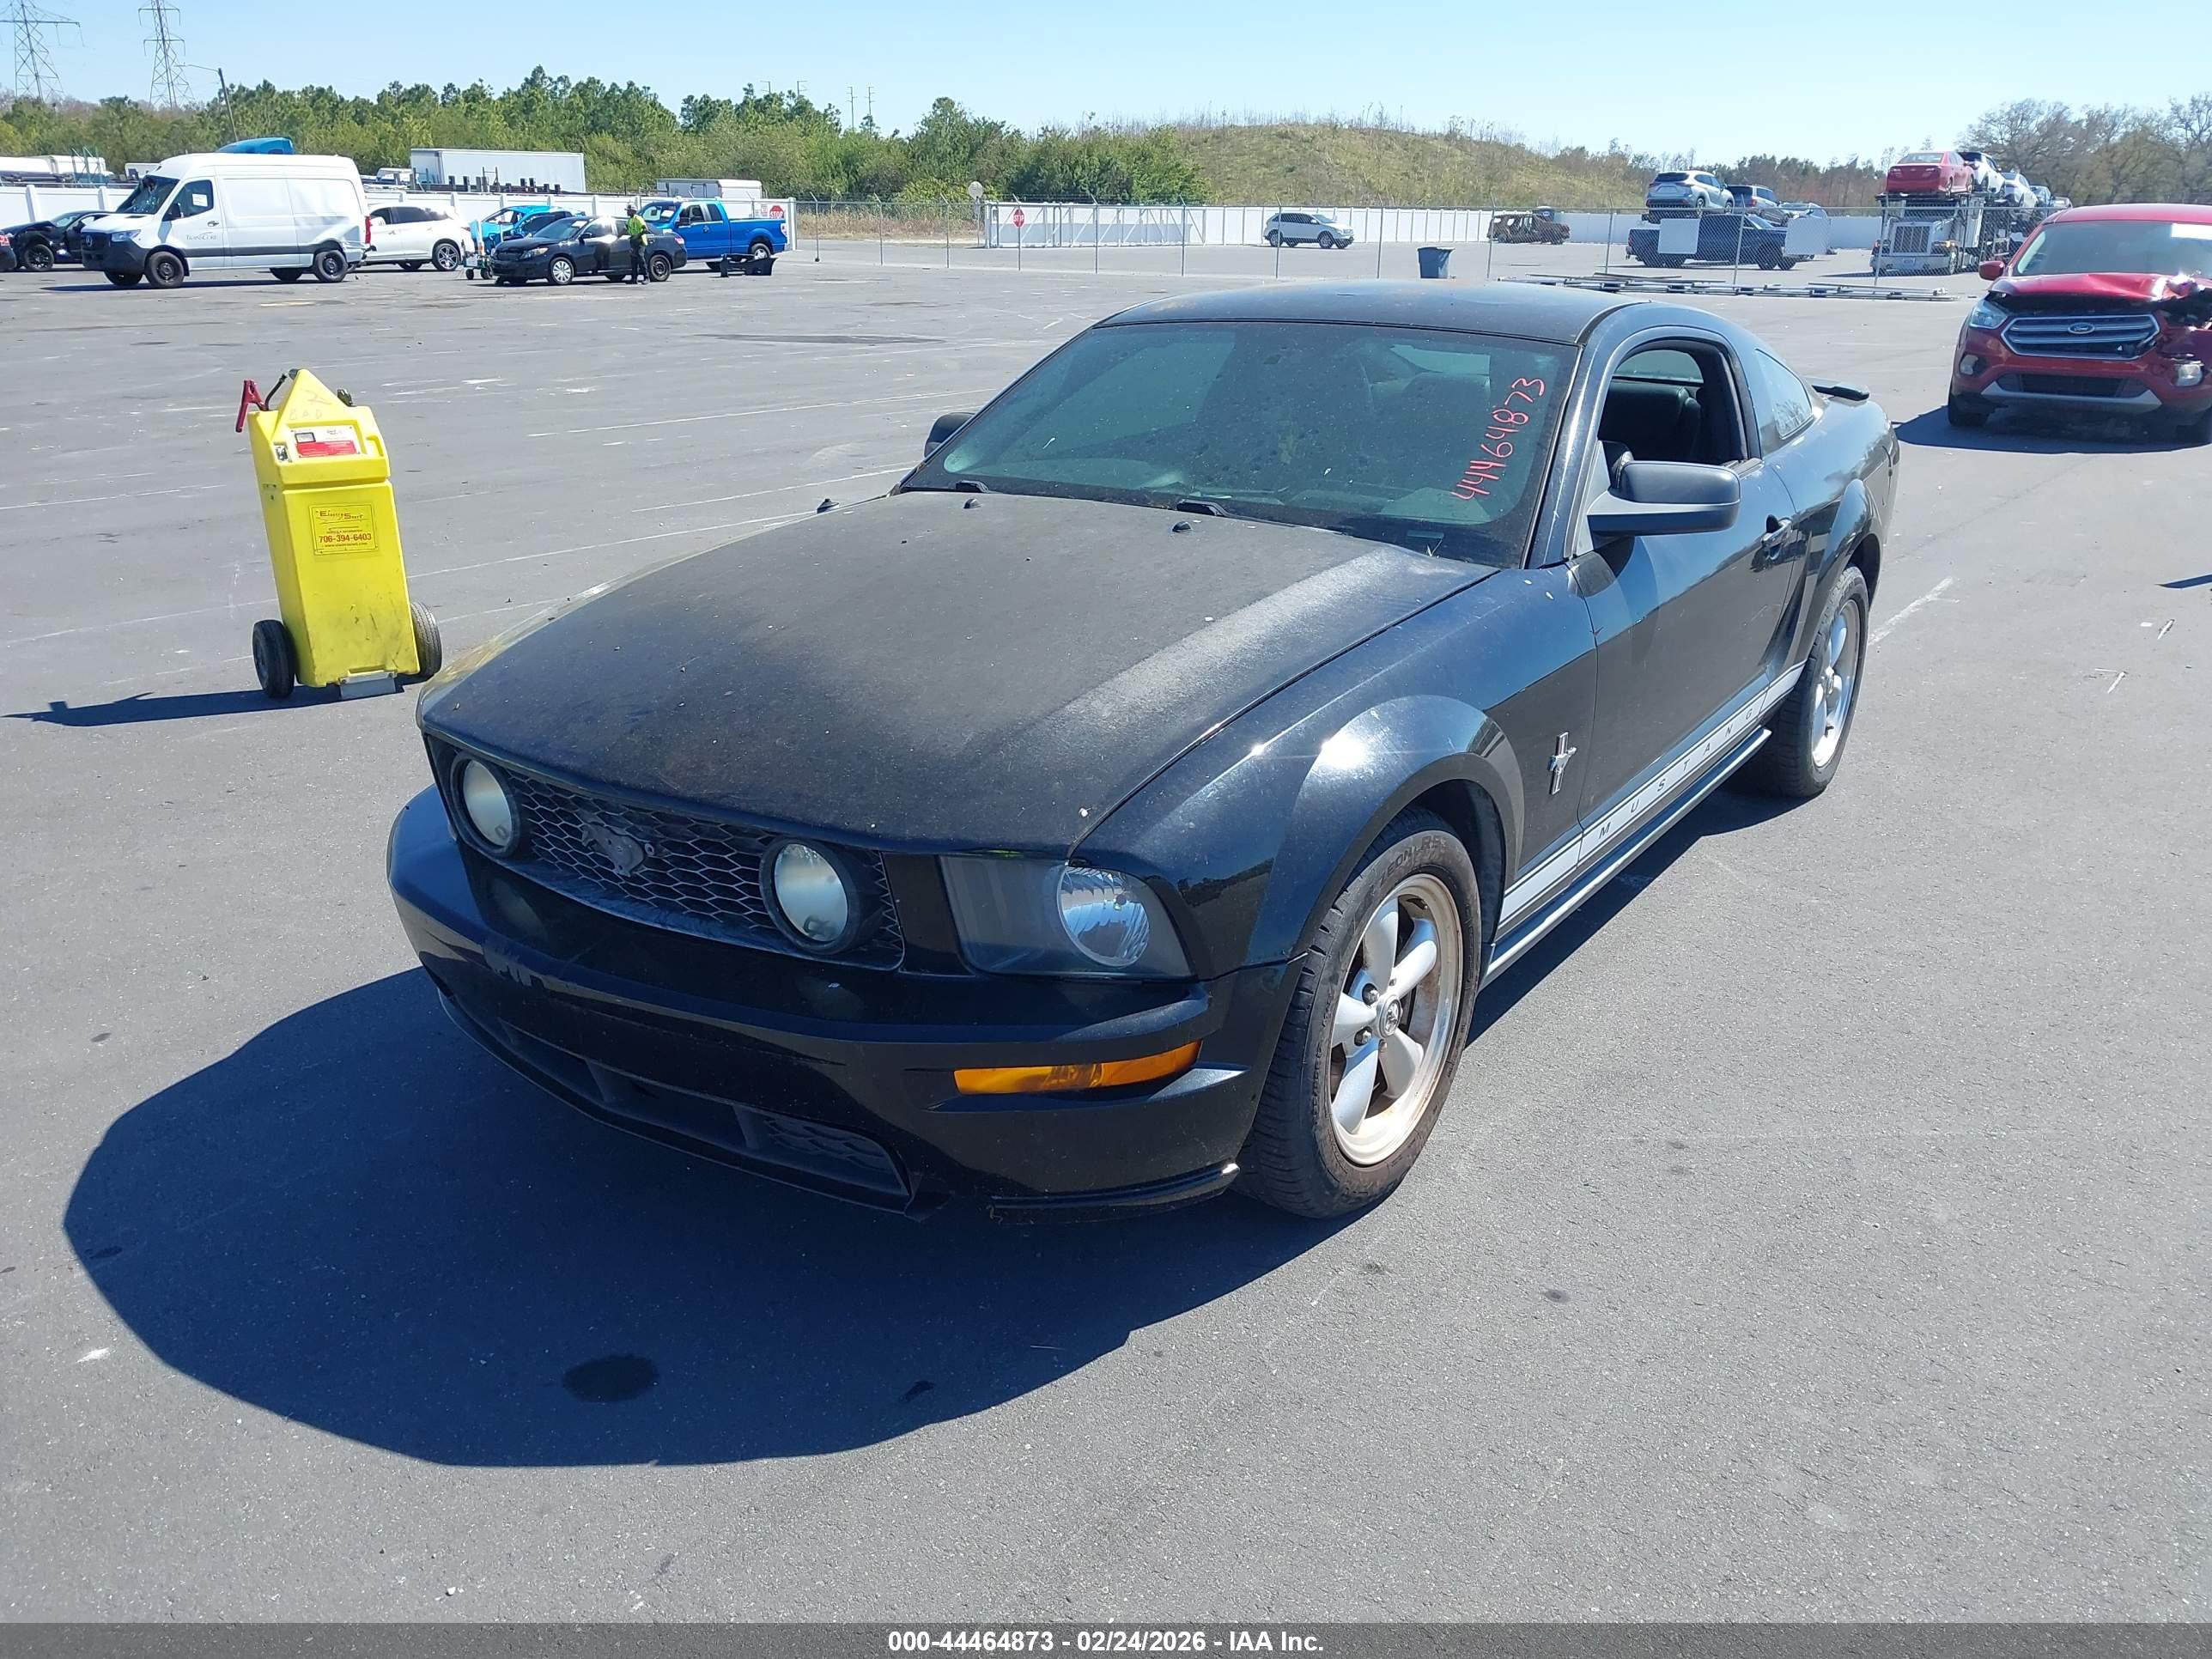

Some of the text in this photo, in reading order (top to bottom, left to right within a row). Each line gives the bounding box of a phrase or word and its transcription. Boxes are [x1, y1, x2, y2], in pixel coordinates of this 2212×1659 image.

[1451, 378, 1545, 500] 44464873
[319, 532, 372, 544] 706-394-6403
[1598, 708, 1753, 839] MUSTANG
